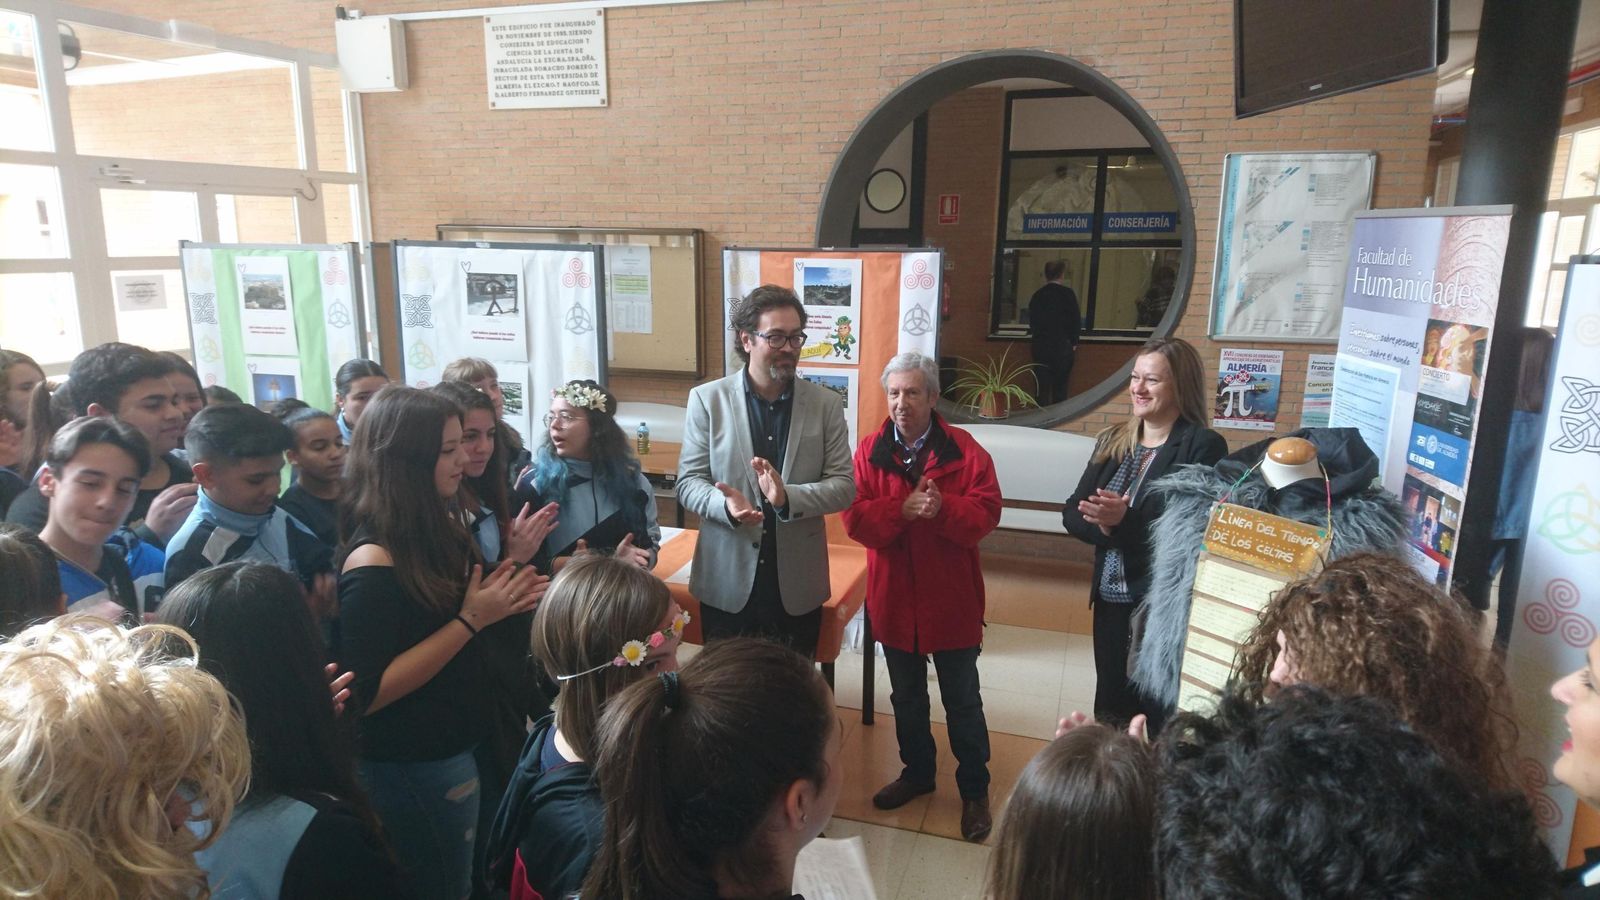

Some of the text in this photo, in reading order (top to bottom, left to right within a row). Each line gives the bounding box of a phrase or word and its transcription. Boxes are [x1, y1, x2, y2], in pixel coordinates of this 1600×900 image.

[1028, 215, 1170, 229] INFORMACIÓN CONSERJERÍA
[1357, 247, 1413, 267] Facultad de
[1353, 267, 1482, 310] Humanidades
[1227, 362, 1267, 373] ALMERÍA
[1393, 355, 1410, 366] mundo
[1423, 367, 1450, 381] CONCIERTO
[1256, 522, 1277, 537] DEL
[1212, 530, 1295, 563] DE LOS CELTAS
